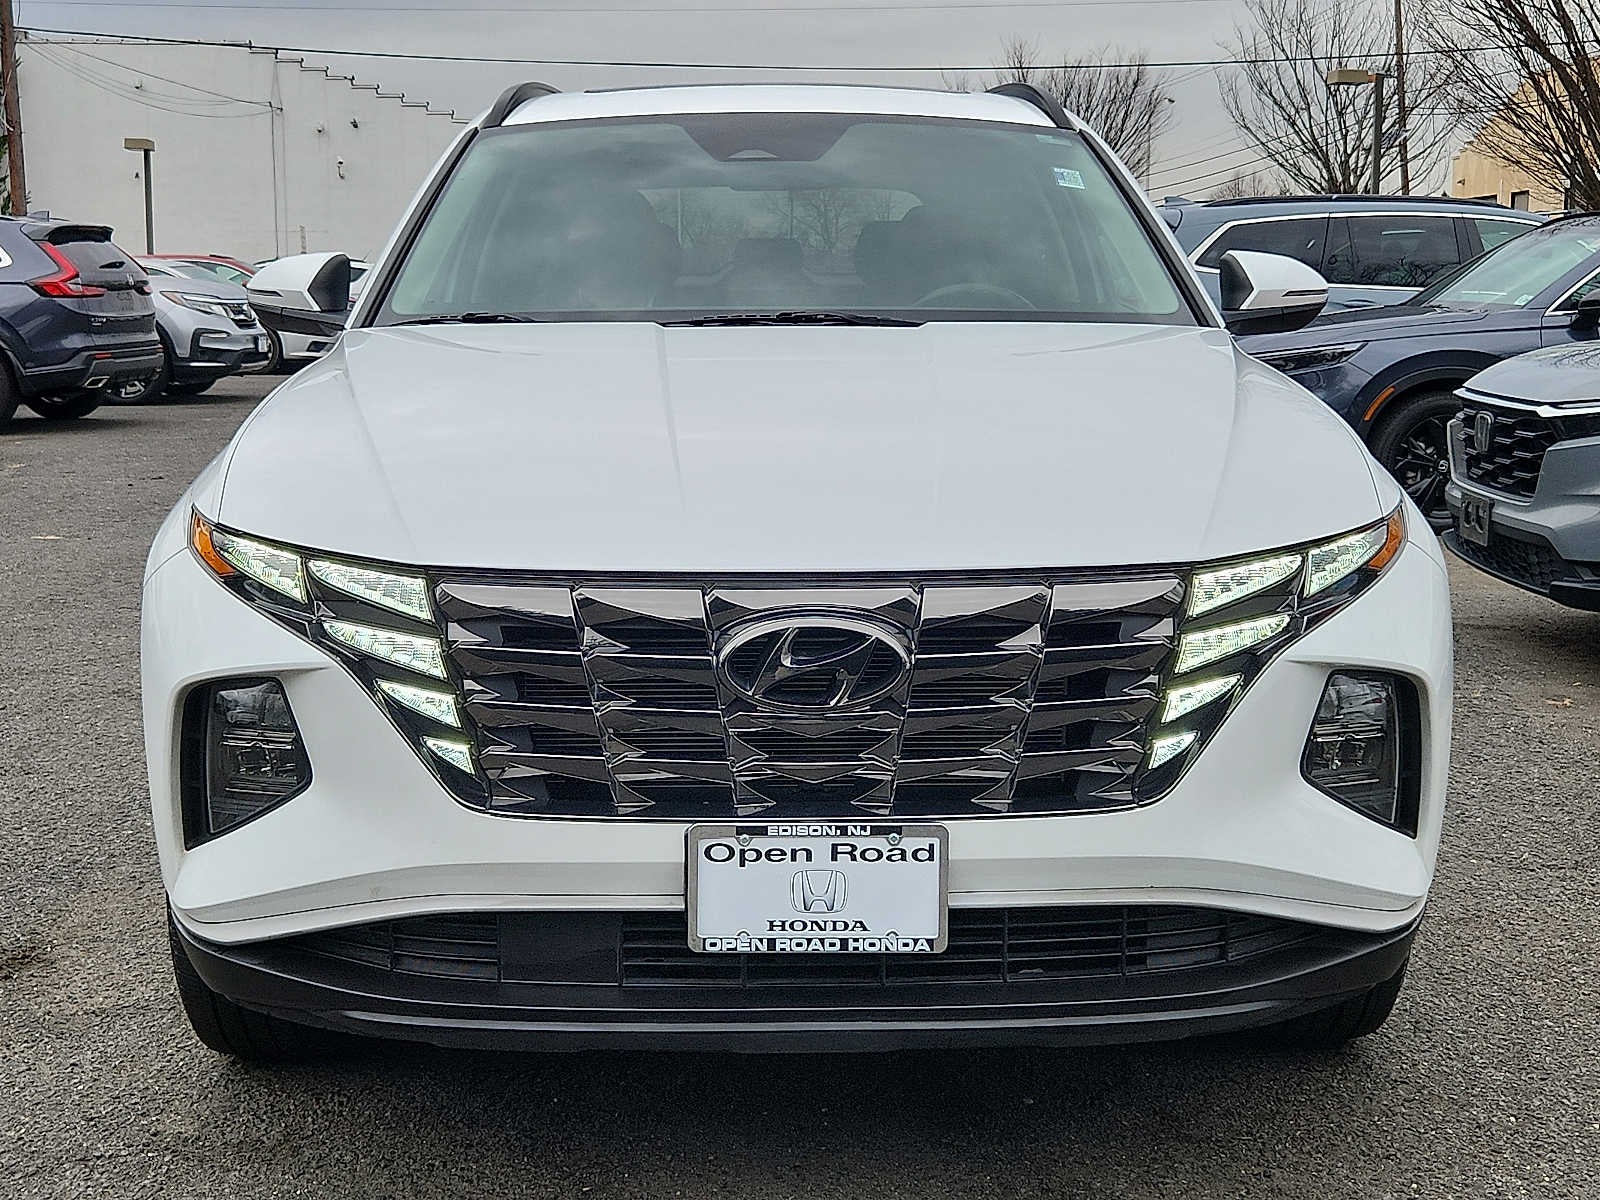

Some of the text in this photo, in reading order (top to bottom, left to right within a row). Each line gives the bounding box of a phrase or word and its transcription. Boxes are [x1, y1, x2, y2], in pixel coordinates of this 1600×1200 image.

[768, 825, 871, 837] EDISON, NJ
[704, 842, 935, 867] Open Road
[767, 920, 870, 932] HONDA
[705, 938, 931, 952] OPEN ROAD HONDA
